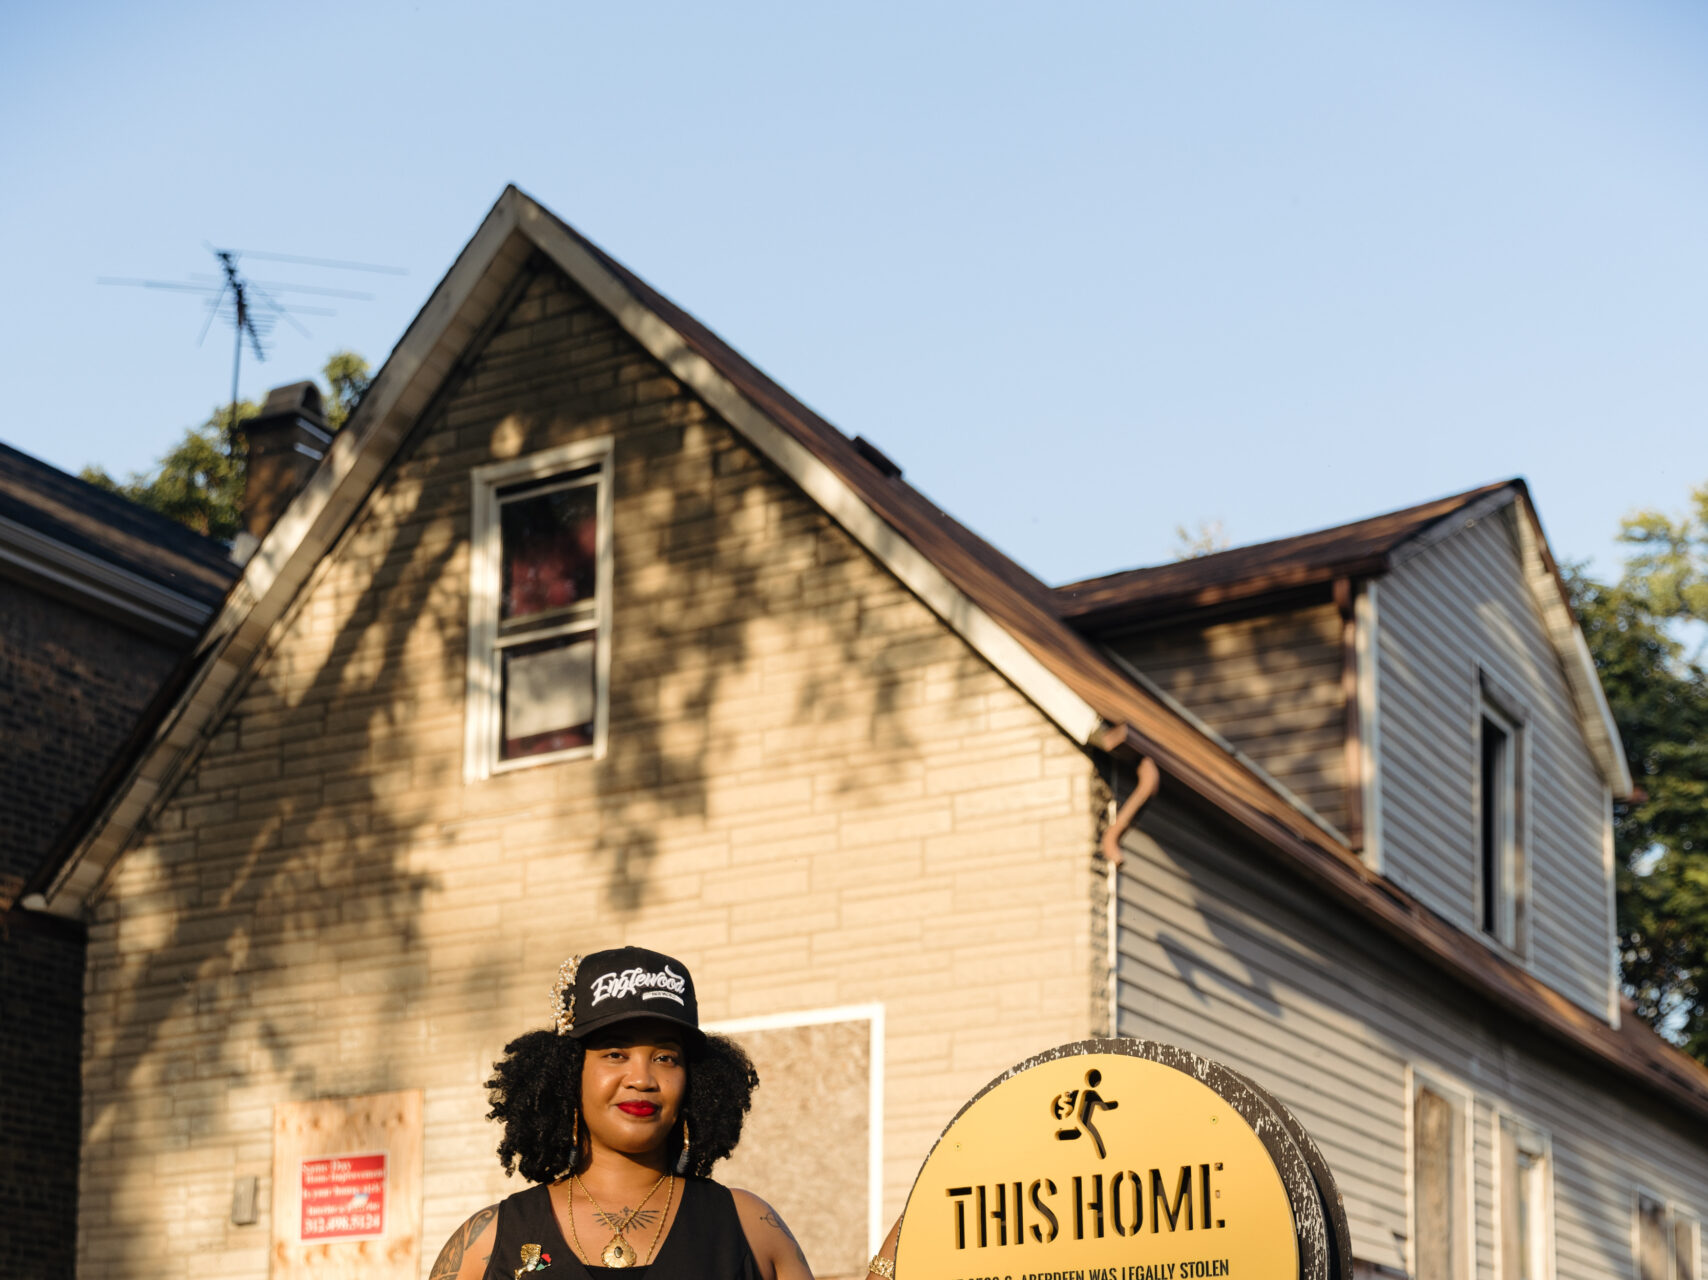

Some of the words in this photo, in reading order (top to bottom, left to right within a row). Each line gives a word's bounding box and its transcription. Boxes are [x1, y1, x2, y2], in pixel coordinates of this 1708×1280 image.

[590, 965, 685, 1006] Englewood
[331, 1160, 352, 1173] Day
[945, 1179, 1059, 1249] THIS
[1072, 1162, 1225, 1240] HOME
[1180, 1259, 1229, 1279] STOLEN
